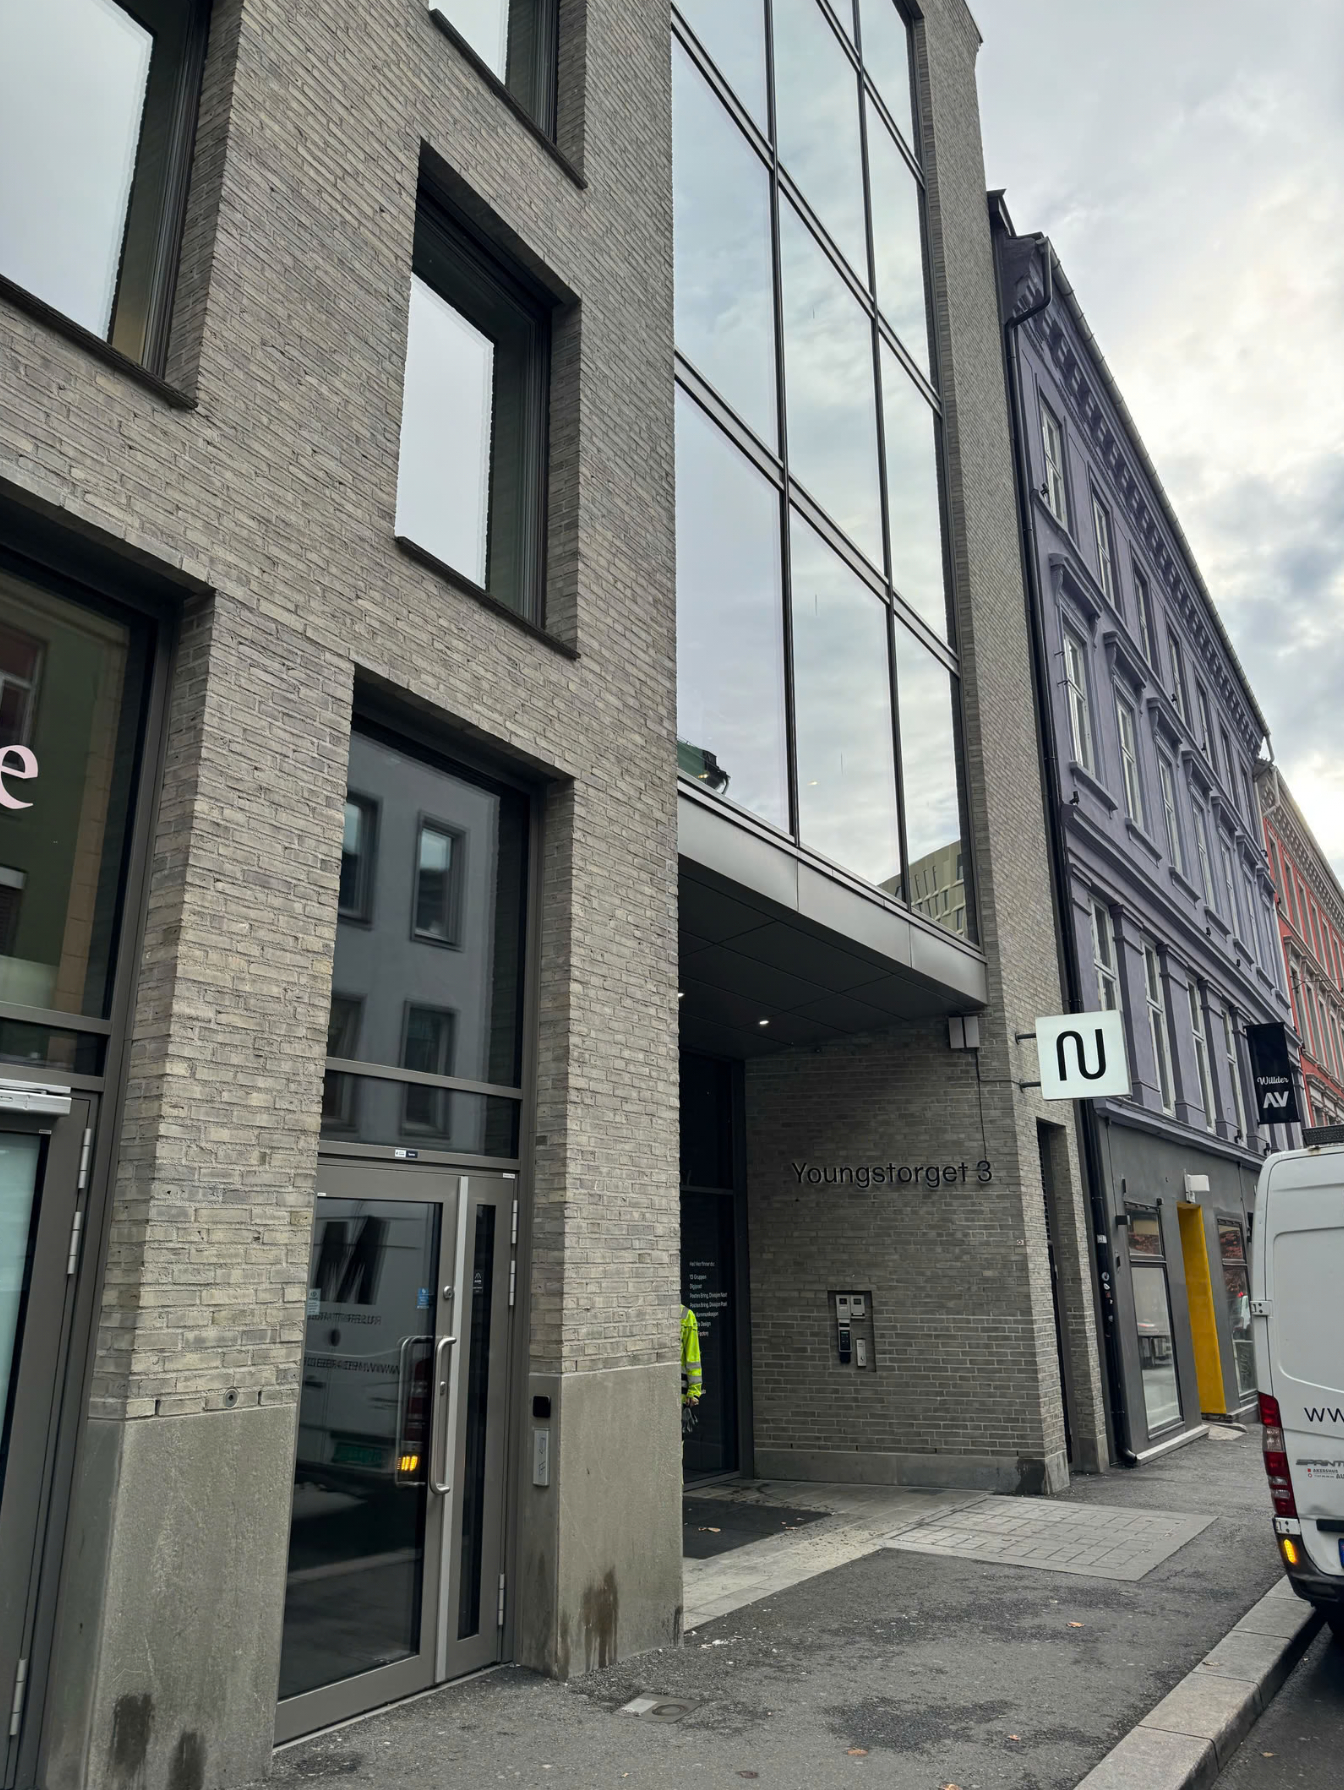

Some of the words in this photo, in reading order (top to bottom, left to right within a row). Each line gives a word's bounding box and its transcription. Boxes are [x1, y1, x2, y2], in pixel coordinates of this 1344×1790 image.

[1263, 1091, 1289, 1109] AV
[791, 1161, 968, 1188] Youngstorget
[977, 1160, 992, 1183] 3
[1296, 1459, 1344, 1467] SPRINT
